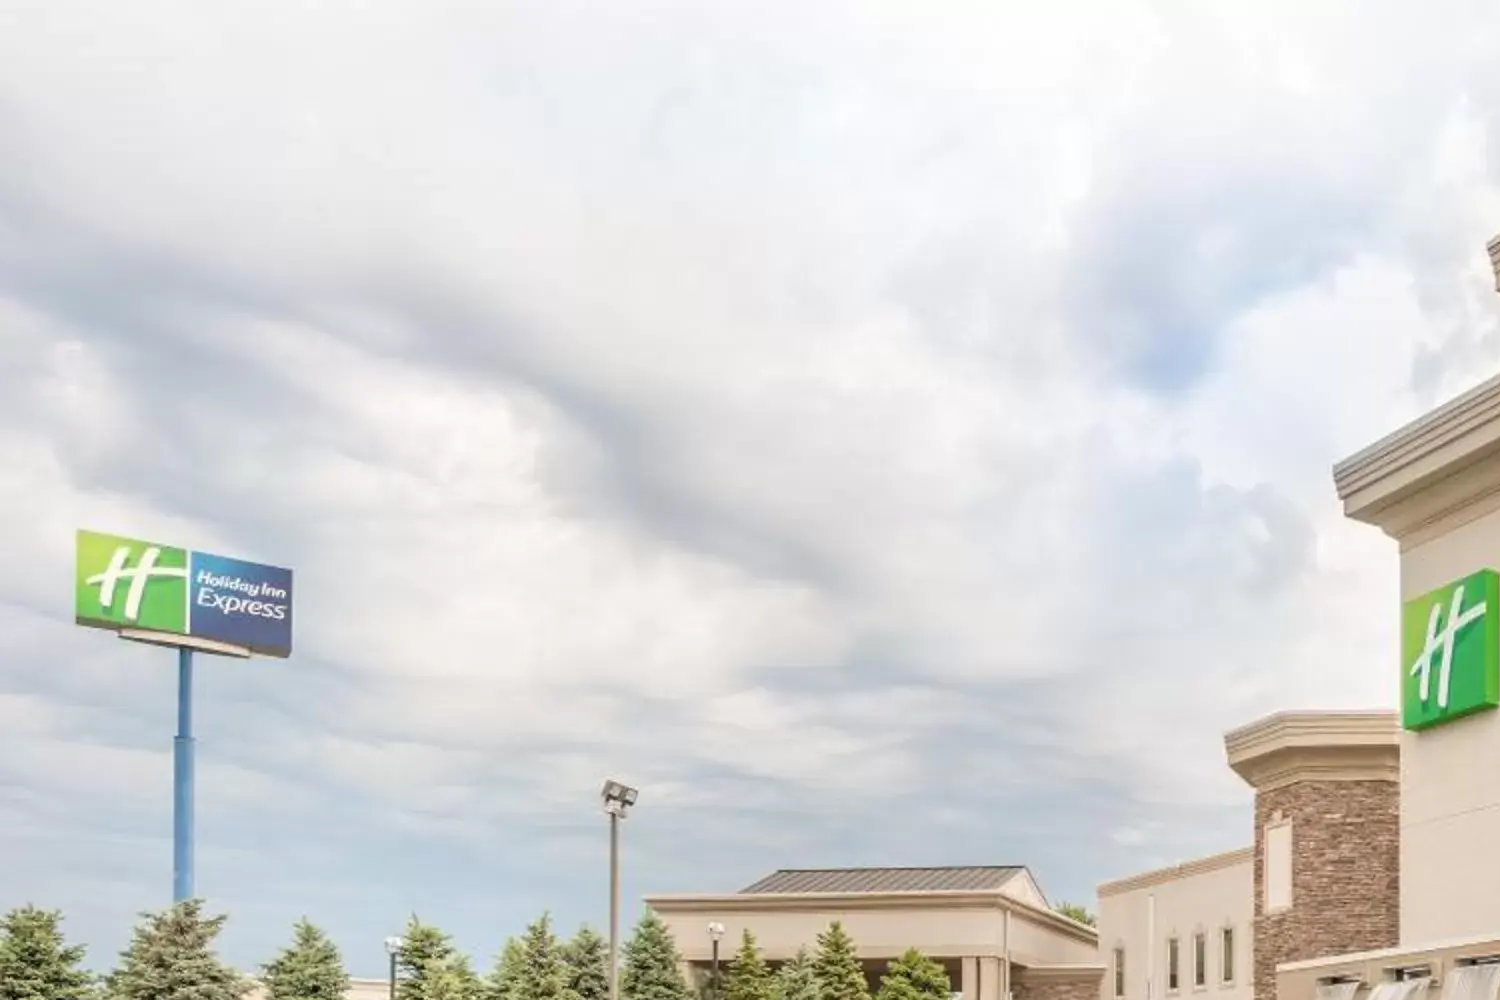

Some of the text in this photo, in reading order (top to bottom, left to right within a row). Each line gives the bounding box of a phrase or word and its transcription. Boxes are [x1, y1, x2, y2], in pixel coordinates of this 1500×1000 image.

[197, 569, 287, 599] Holiday Inn
[197, 587, 288, 620] Express
